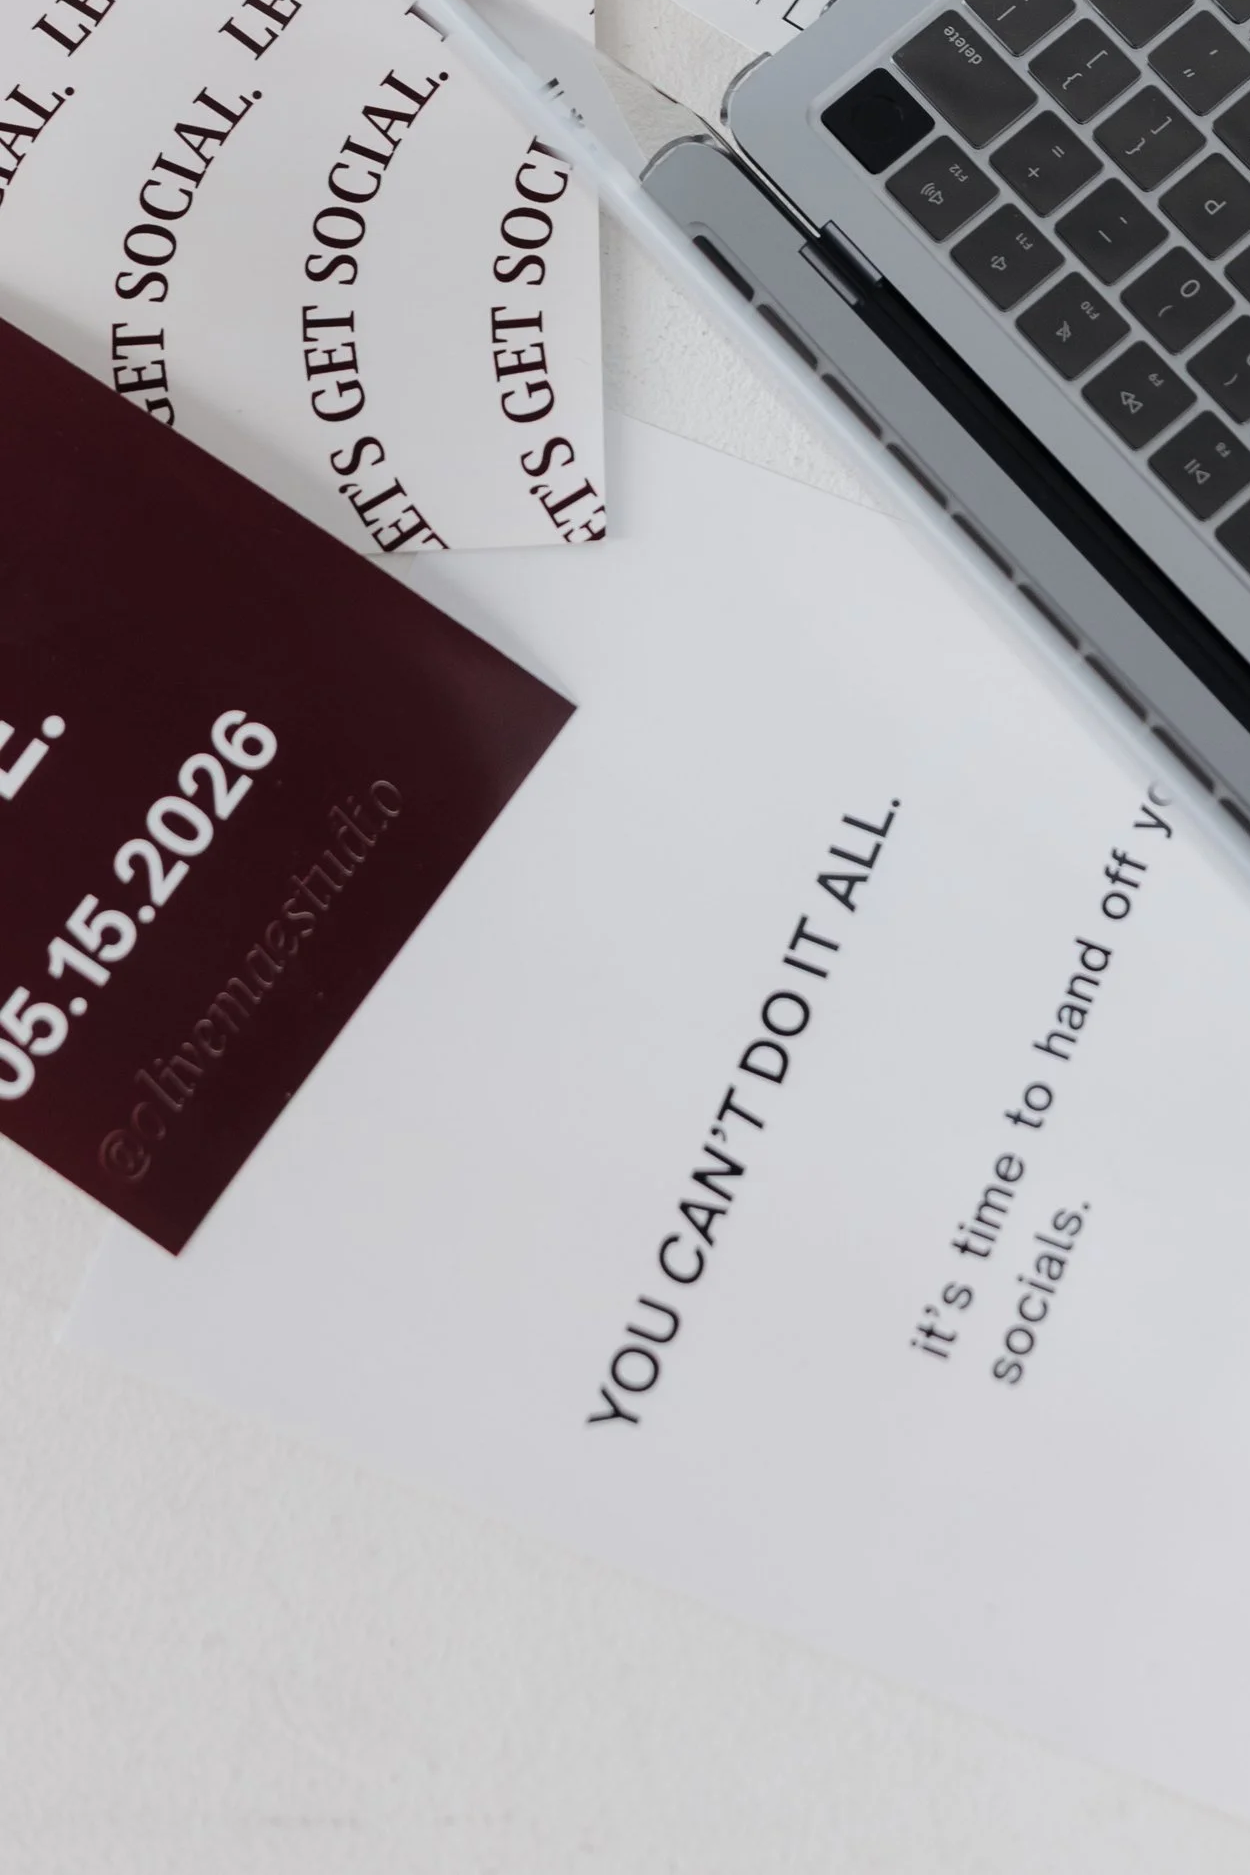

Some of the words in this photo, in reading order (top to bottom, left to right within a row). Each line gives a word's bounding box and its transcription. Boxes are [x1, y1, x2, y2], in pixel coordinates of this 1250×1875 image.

[942, 24, 984, 66] delete
[114, 84, 263, 304] SOCIAL.
[304, 70, 451, 286] SOCIAL.
[1203, 198, 1228, 217] P
[301, 304, 366, 423] GET
[490, 305, 557, 424] GET
[0, 709, 278, 1101] 05.15.2026
[1098, 846, 1150, 923] off
[99, 779, 402, 1182] @olivemaestudio
[1030, 935, 1115, 1063] hand
[587, 1295, 682, 1426] YOU
[657, 1084, 766, 1286] CAN'T
[737, 989, 812, 1086] DO
[782, 914, 841, 980] IT
[819, 796, 903, 913] ALL.
[1005, 1080, 1056, 1131] to
[950, 1151, 1027, 1262] time
[908, 1281, 976, 1362] it's
[990, 1201, 1092, 1388] socials.
